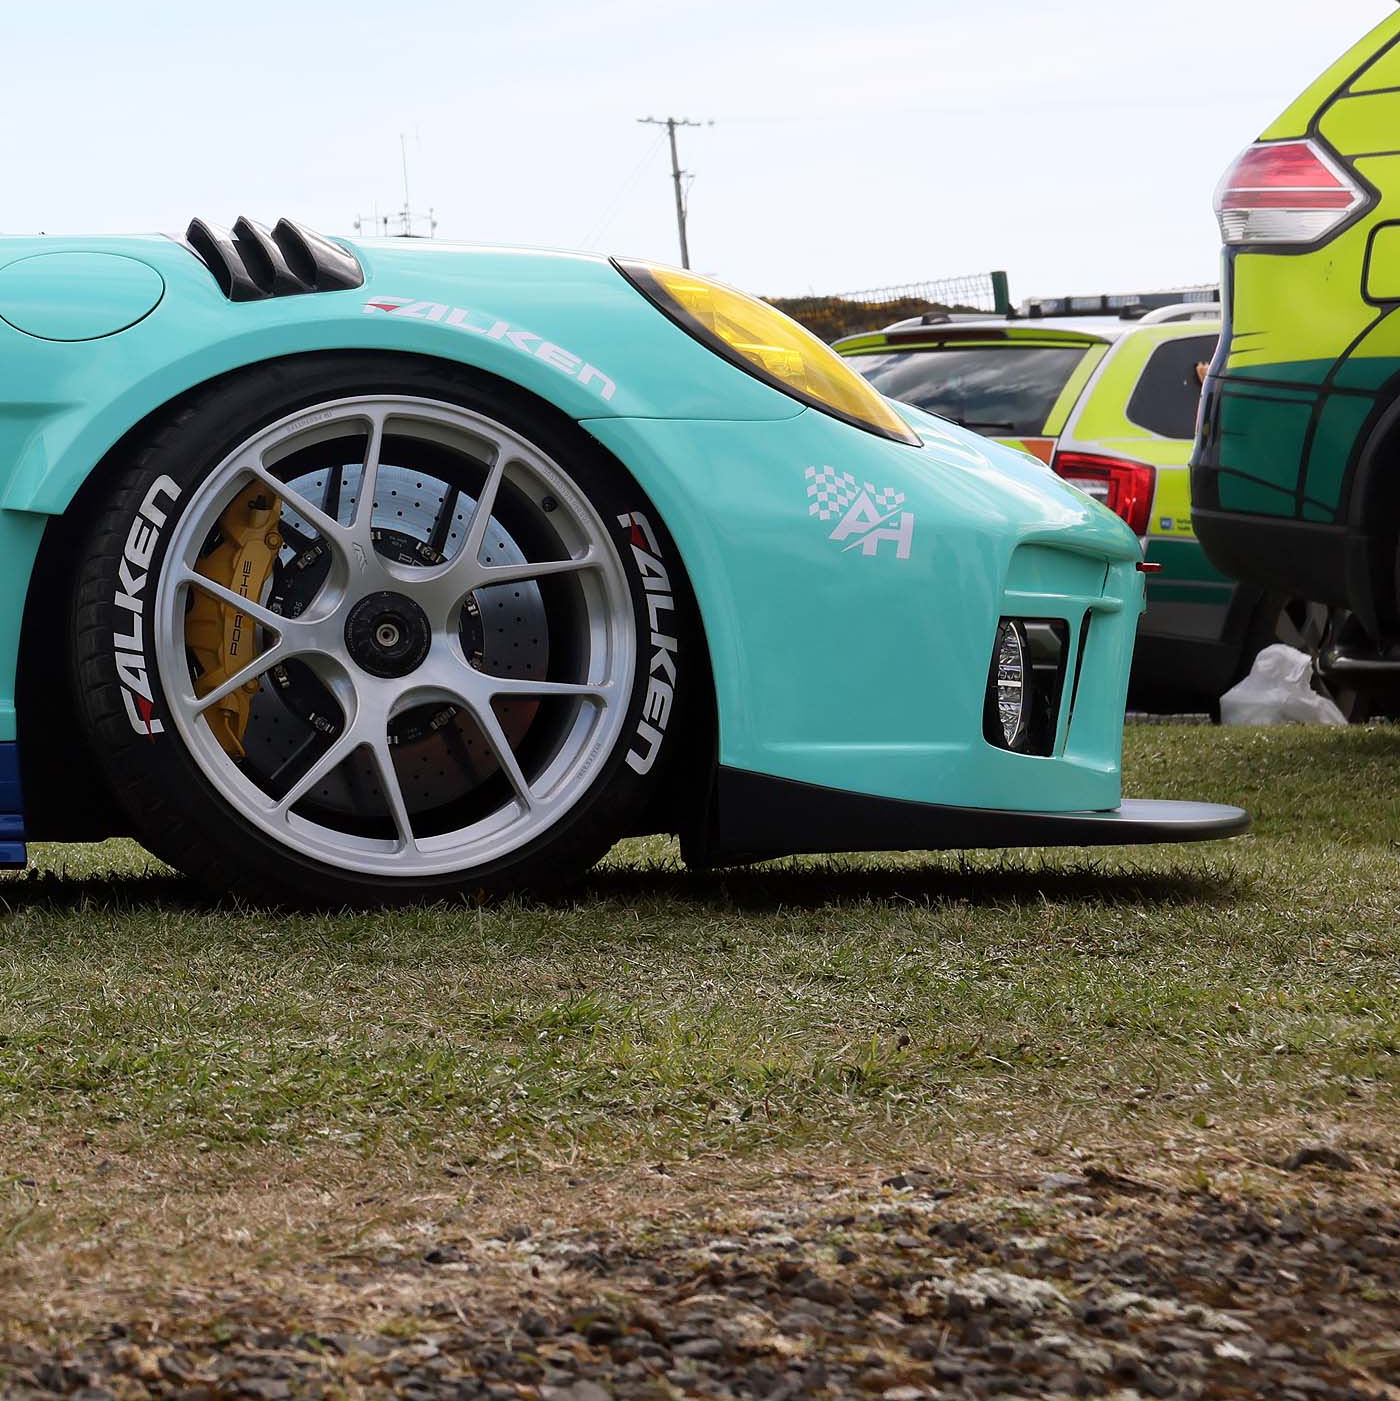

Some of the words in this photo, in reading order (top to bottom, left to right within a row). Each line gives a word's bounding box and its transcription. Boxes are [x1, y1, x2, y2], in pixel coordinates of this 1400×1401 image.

[363, 295, 617, 401] FALKEN
[113, 474, 182, 737] FALKEN
[229, 560, 252, 656] PORCHE
[617, 510, 678, 776] FALKEN
